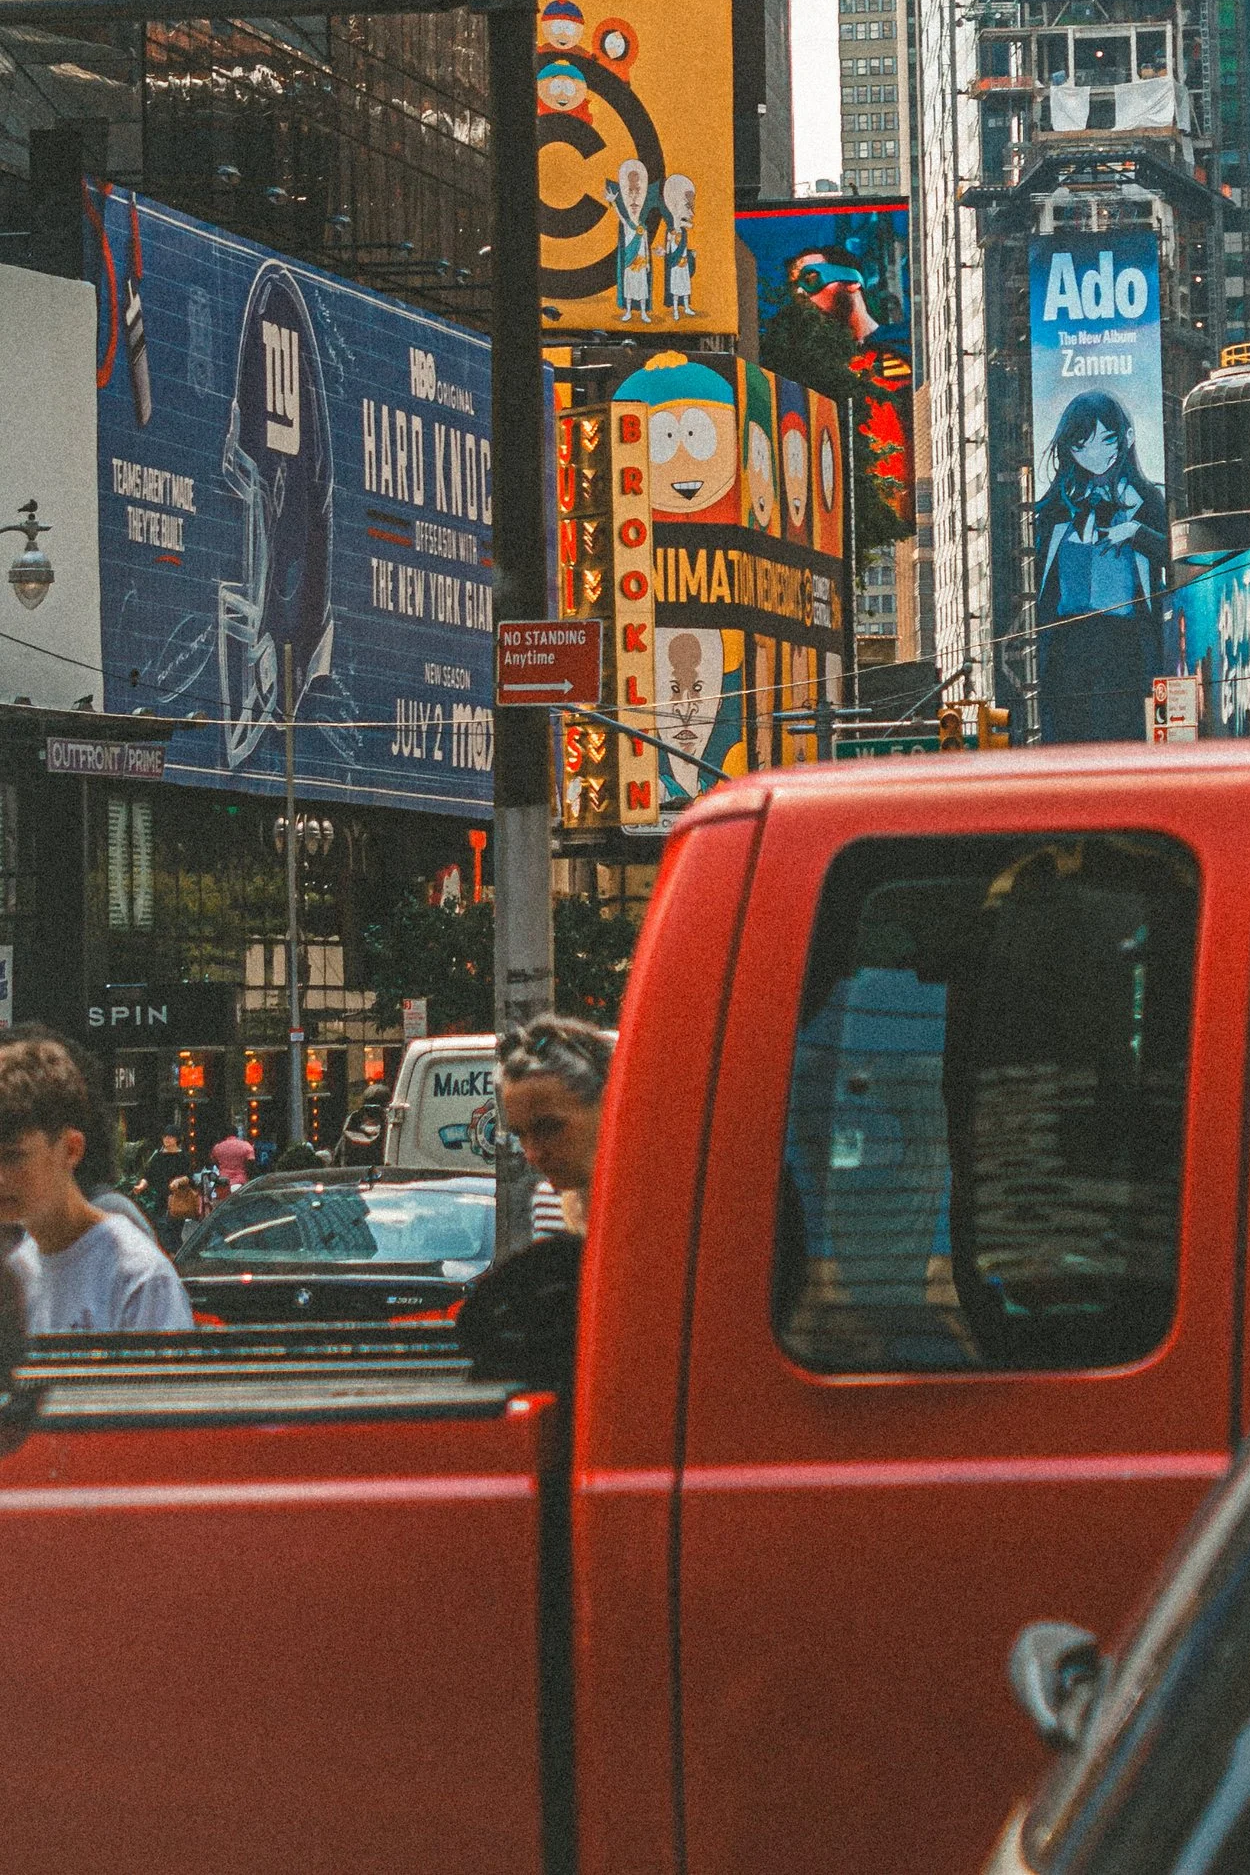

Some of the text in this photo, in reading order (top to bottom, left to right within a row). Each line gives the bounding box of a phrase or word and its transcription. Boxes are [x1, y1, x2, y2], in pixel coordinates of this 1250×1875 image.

[1043, 249, 1149, 324] Ado
[1058, 331, 1077, 345] The
[1061, 349, 1133, 377] Zanmu
[409, 347, 475, 416] HBO ORIGINAL
[363, 397, 492, 525] HARD KNOC
[112, 457, 142, 500] TEAMS
[371, 557, 394, 611] THE
[398, 564, 425, 618] NEW
[429, 573, 461, 625] YORK
[504, 629, 587, 646] NO STANDING
[504, 649, 556, 669] Anytime
[424, 662, 471, 691] NEW SEASON
[391, 698, 431, 760] JULY
[433, 703, 443, 761] 2
[53, 742, 121, 771] OUTFRONT
[89, 1005, 168, 1027] SPIN
